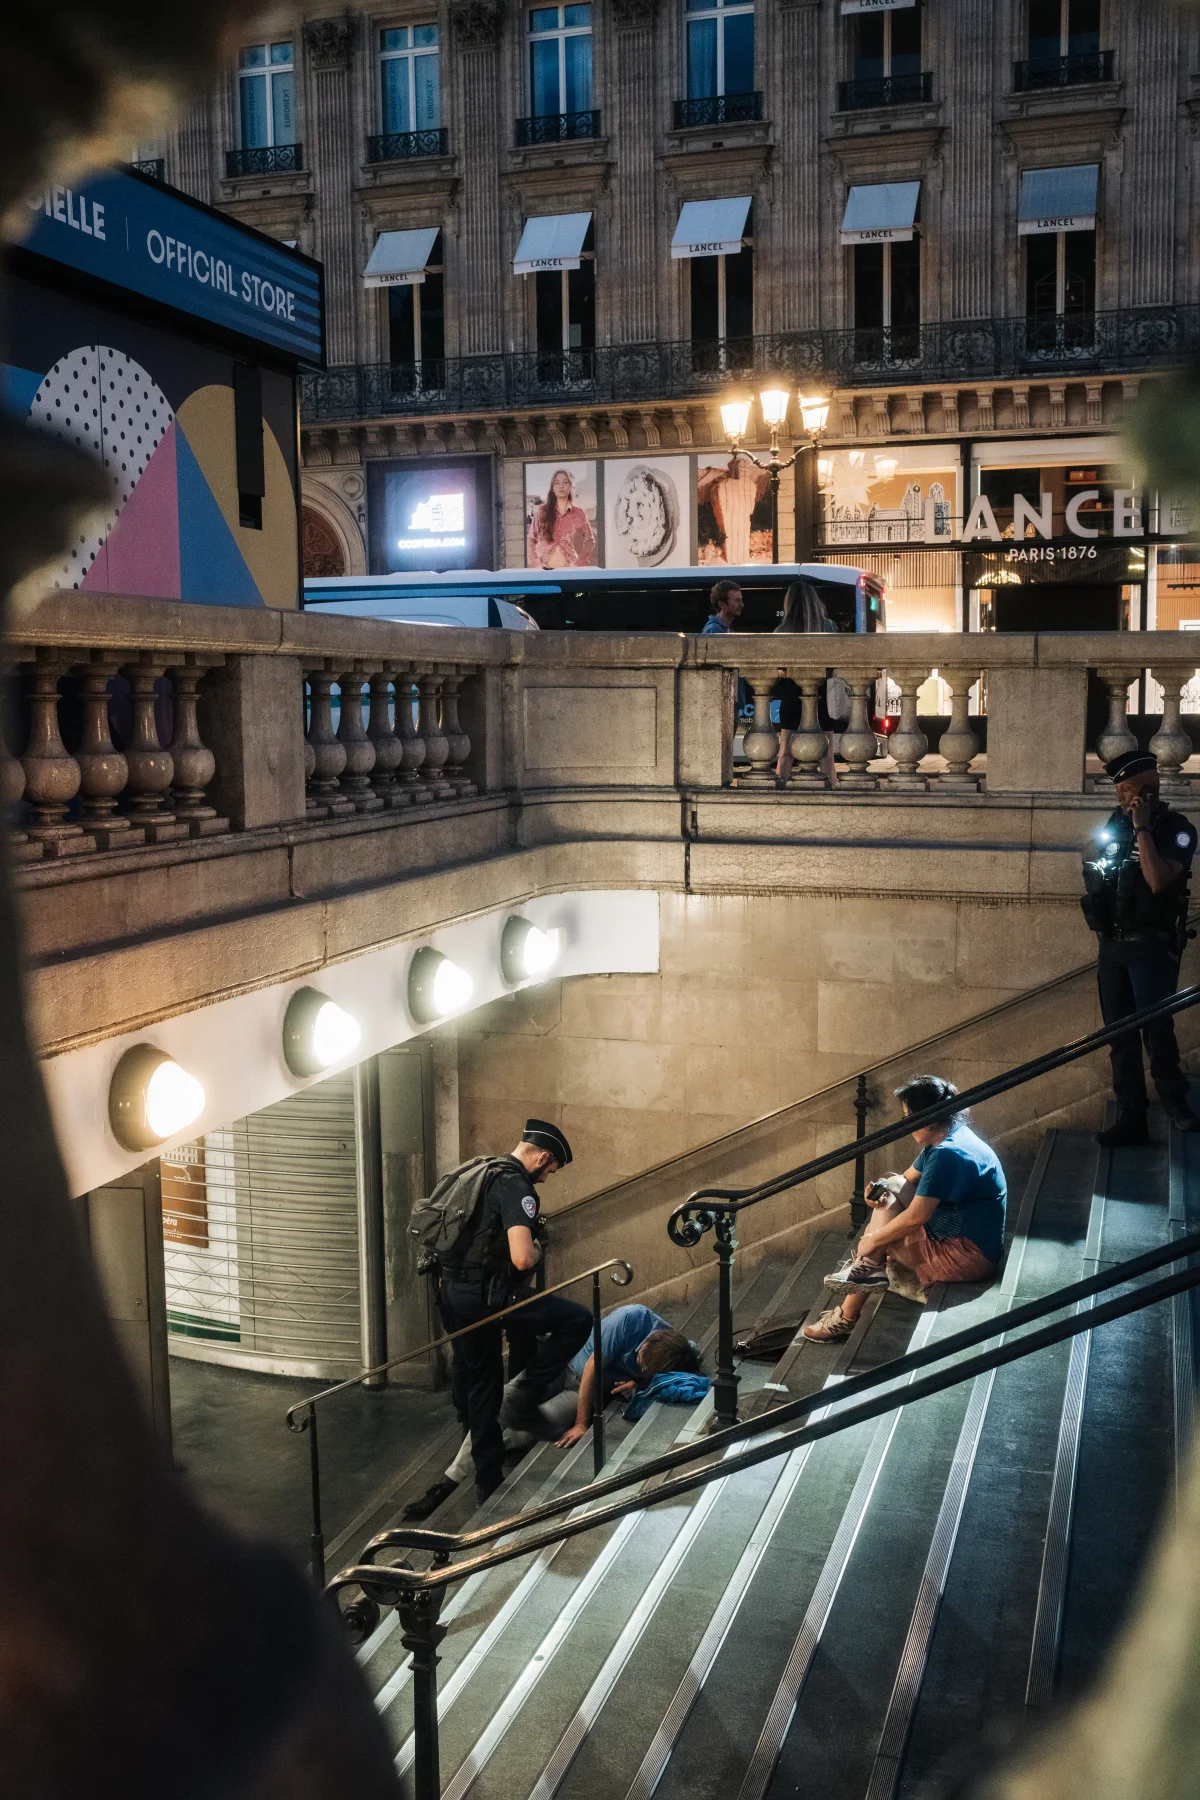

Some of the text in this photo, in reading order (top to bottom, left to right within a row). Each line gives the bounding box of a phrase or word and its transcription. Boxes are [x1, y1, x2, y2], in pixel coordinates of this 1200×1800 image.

[426, 79, 434, 120] EURONEXT
[283, 89, 291, 128] EURONEXT
[1037, 218, 1075, 228] LANCEL
[860, 230, 894, 239] LANCEL
[689, 243, 723, 253] LANCEL
[530, 258, 563, 268] LANCEL
[147, 229, 296, 321] OFFICIAL STORE
[380, 273, 408, 283] LANCEL
[924, 489, 1189, 545] LANCEL
[1009, 545, 1097, 561] PARIS 1876
